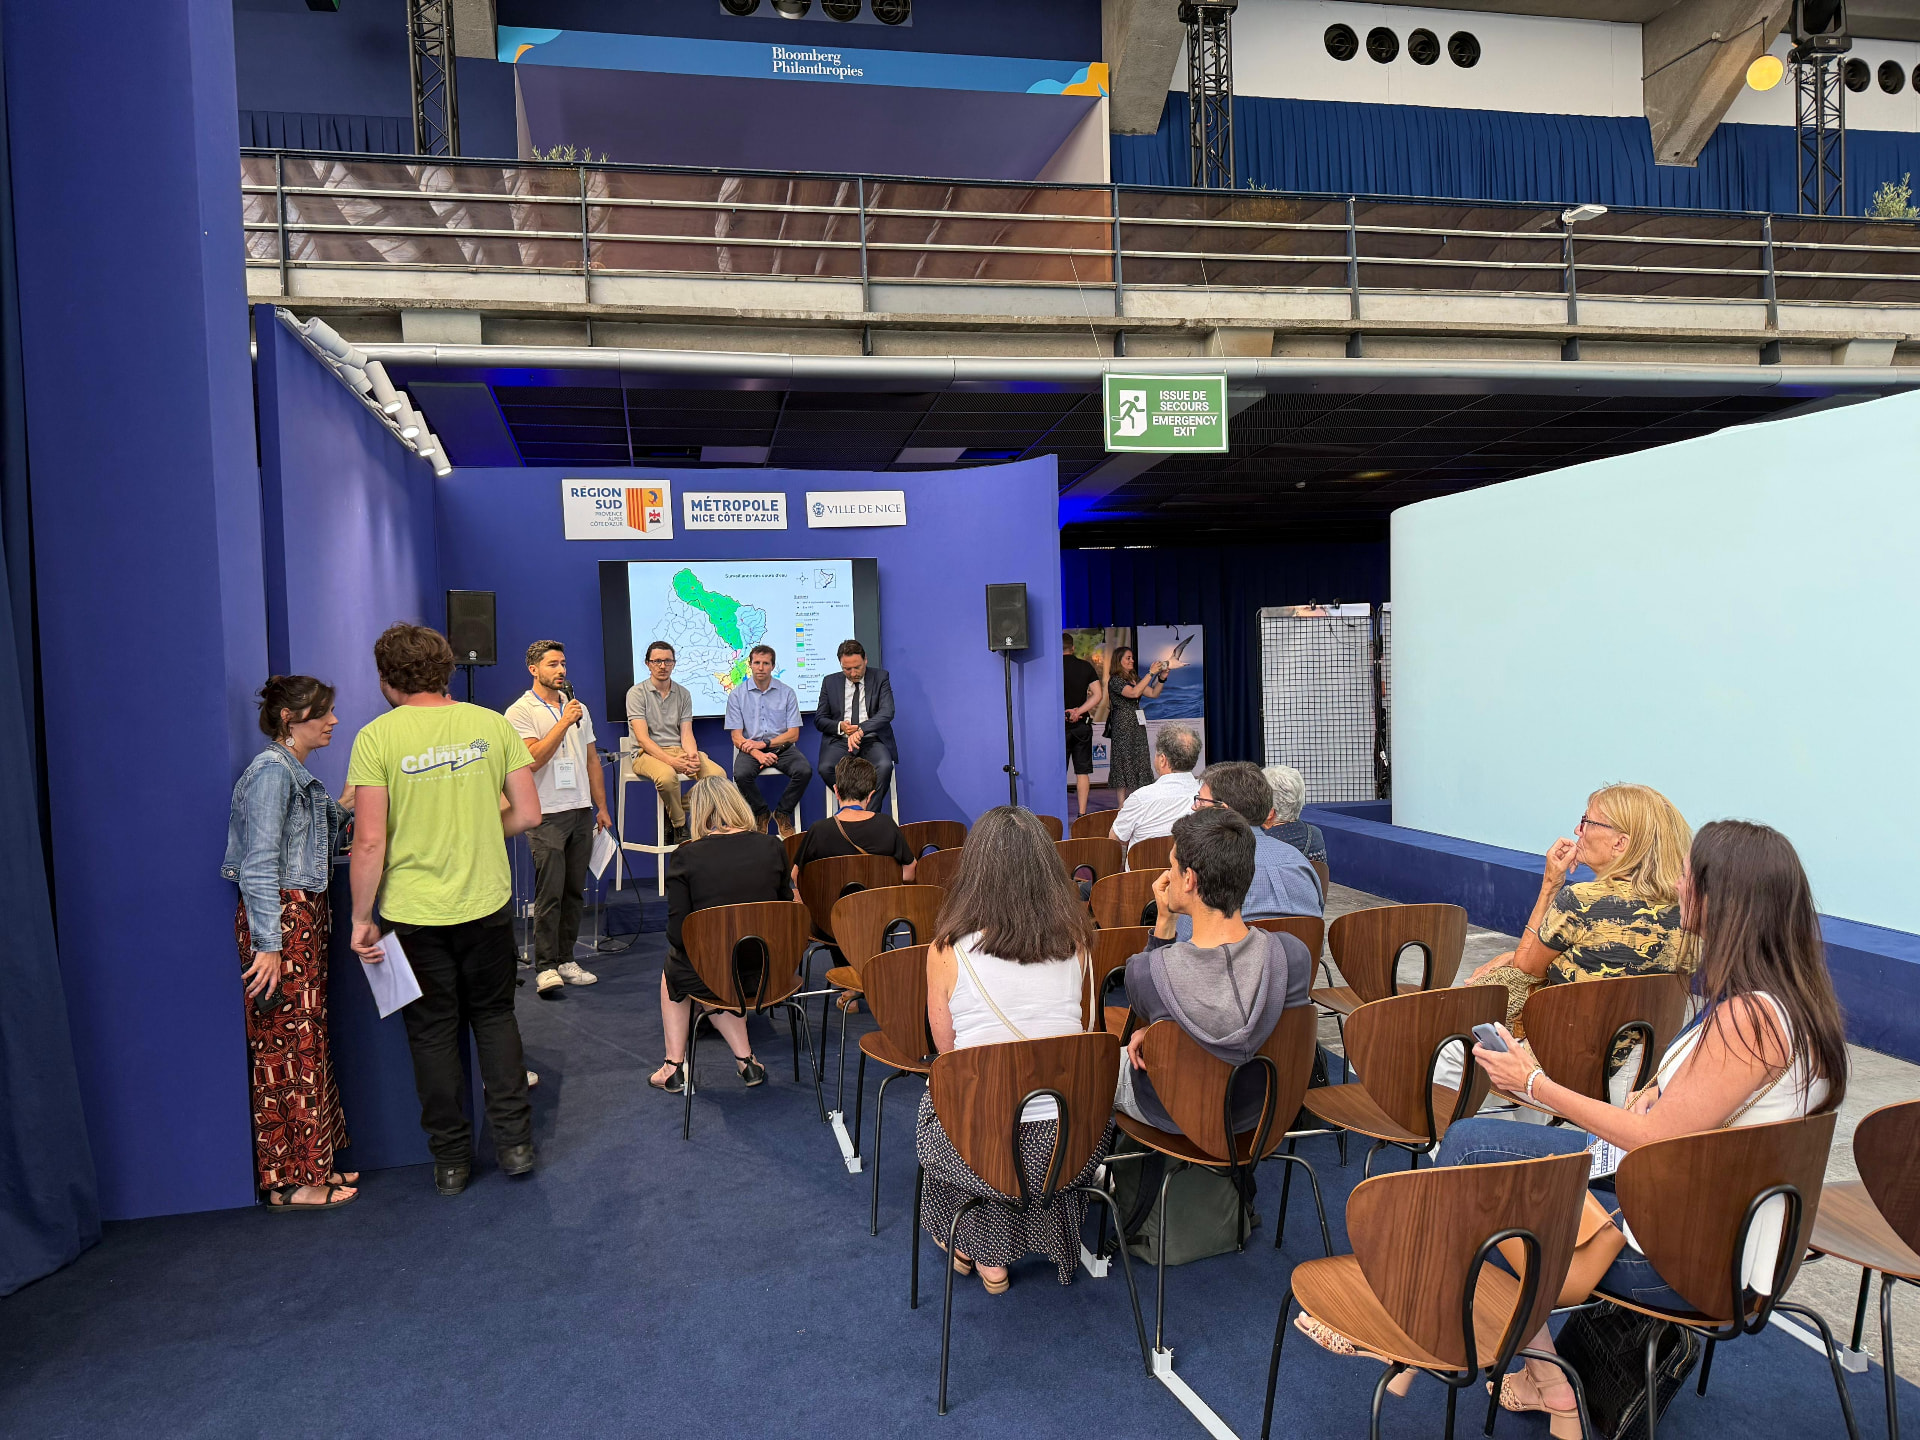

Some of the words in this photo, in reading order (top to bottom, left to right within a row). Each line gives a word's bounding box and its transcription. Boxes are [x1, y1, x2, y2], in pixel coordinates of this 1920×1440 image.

[772, 46, 841, 66] Bloomberg
[773, 60, 863, 80] Philanthropies
[1159, 390, 1190, 400] ISSUE
[1192, 390, 1207, 401] DE
[1160, 401, 1209, 412] SECOURS
[1152, 415, 1218, 426] EMERGENCY
[1173, 426, 1197, 437] EXIT
[595, 499, 623, 510] SUD
[691, 495, 779, 512] MÉTROPOLE
[827, 504, 856, 514] VILLE
[858, 504, 873, 514] DE
[875, 503, 902, 513] NICE
[691, 513, 715, 522] NICE
[717, 511, 743, 522] CÔTE
[745, 513, 780, 522] D'AZUR
